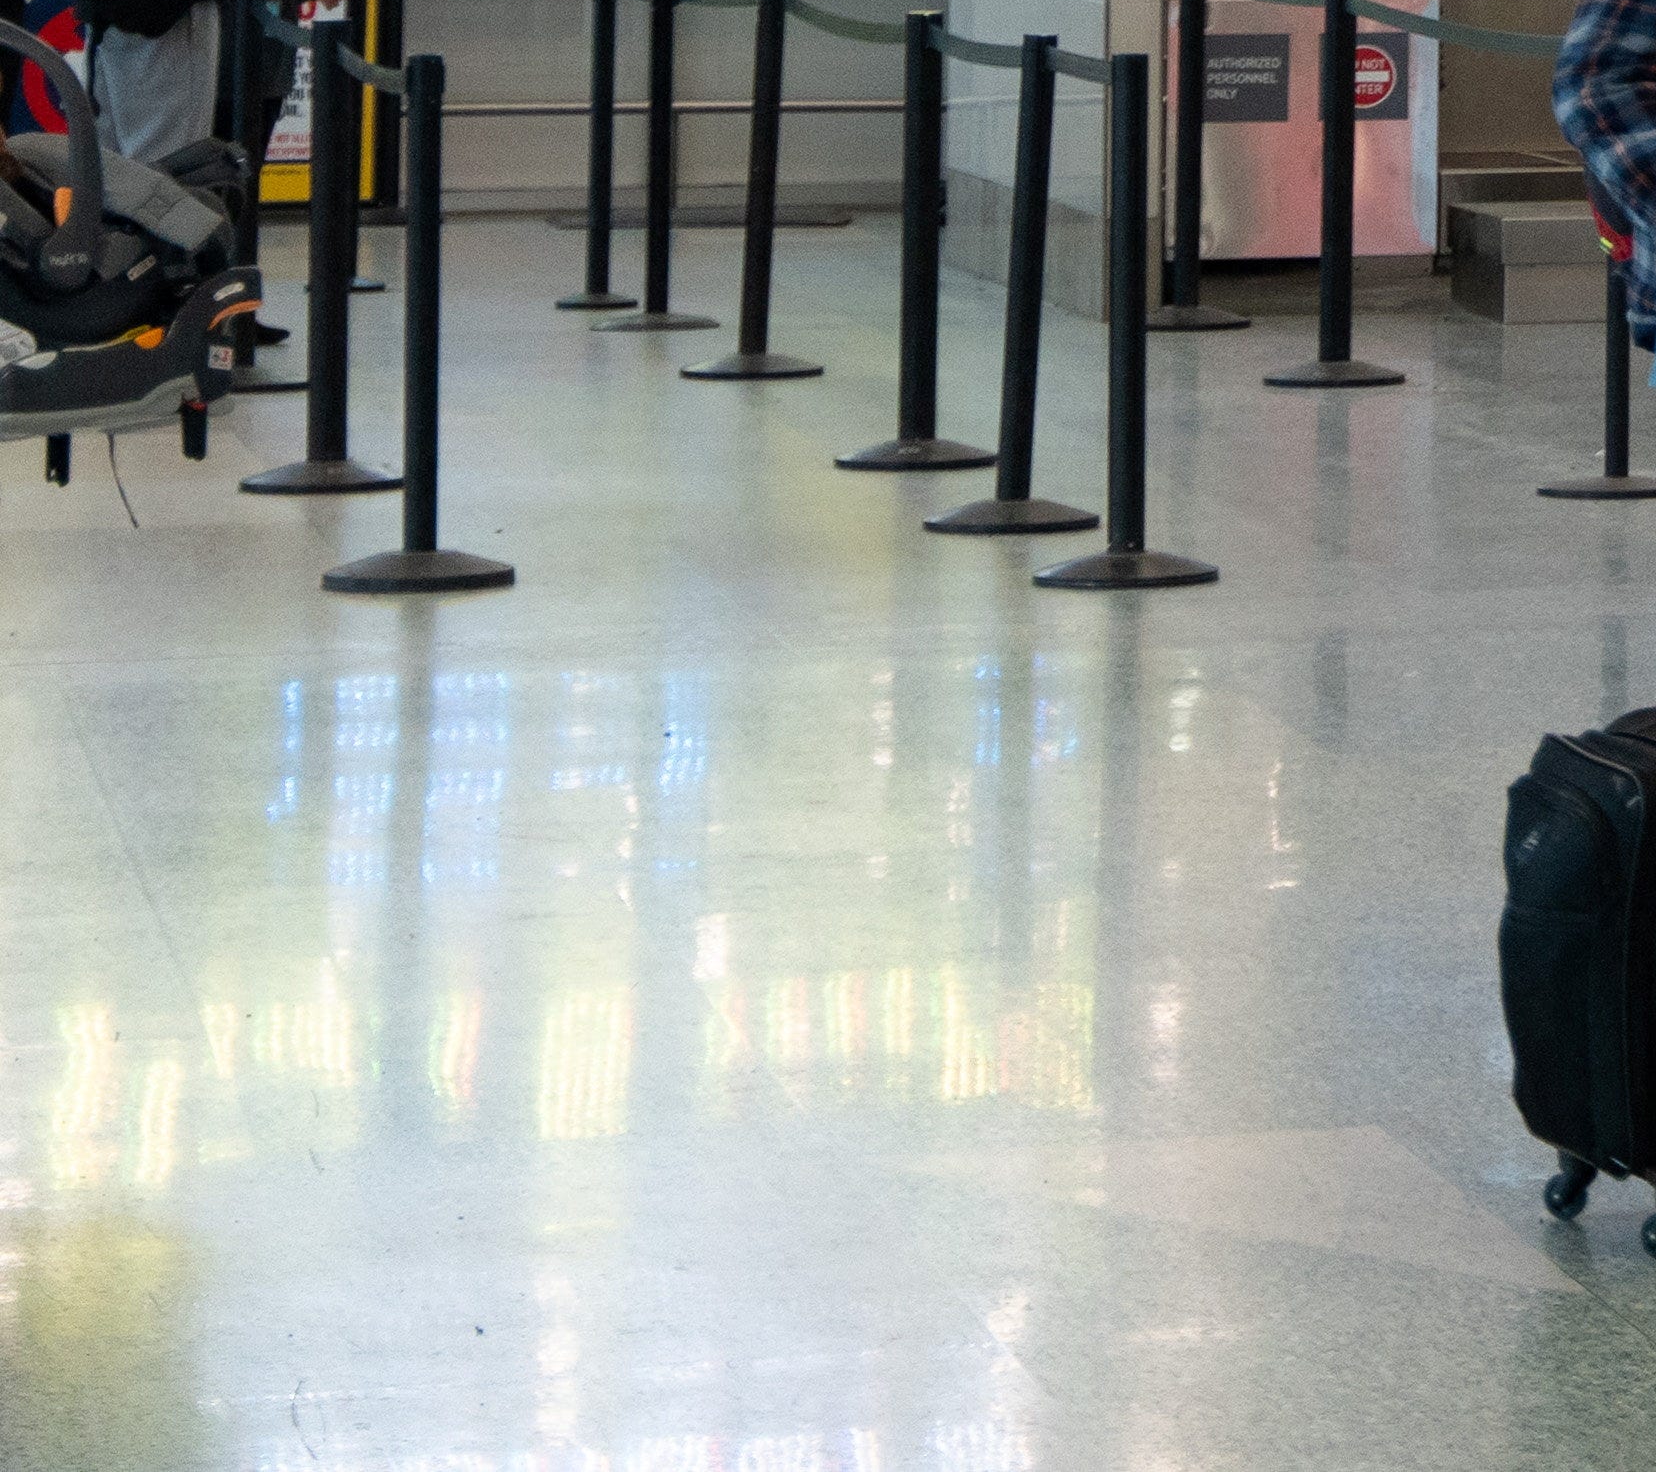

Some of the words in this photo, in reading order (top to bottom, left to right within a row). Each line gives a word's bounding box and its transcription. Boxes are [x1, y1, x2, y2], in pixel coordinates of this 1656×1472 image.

[1206, 57, 1282, 70] AUTHORIZED
[1206, 71, 1278, 85] PERSONNEL
[1206, 87, 1238, 99] ONLY
[1355, 84, 1383, 96] NTER
